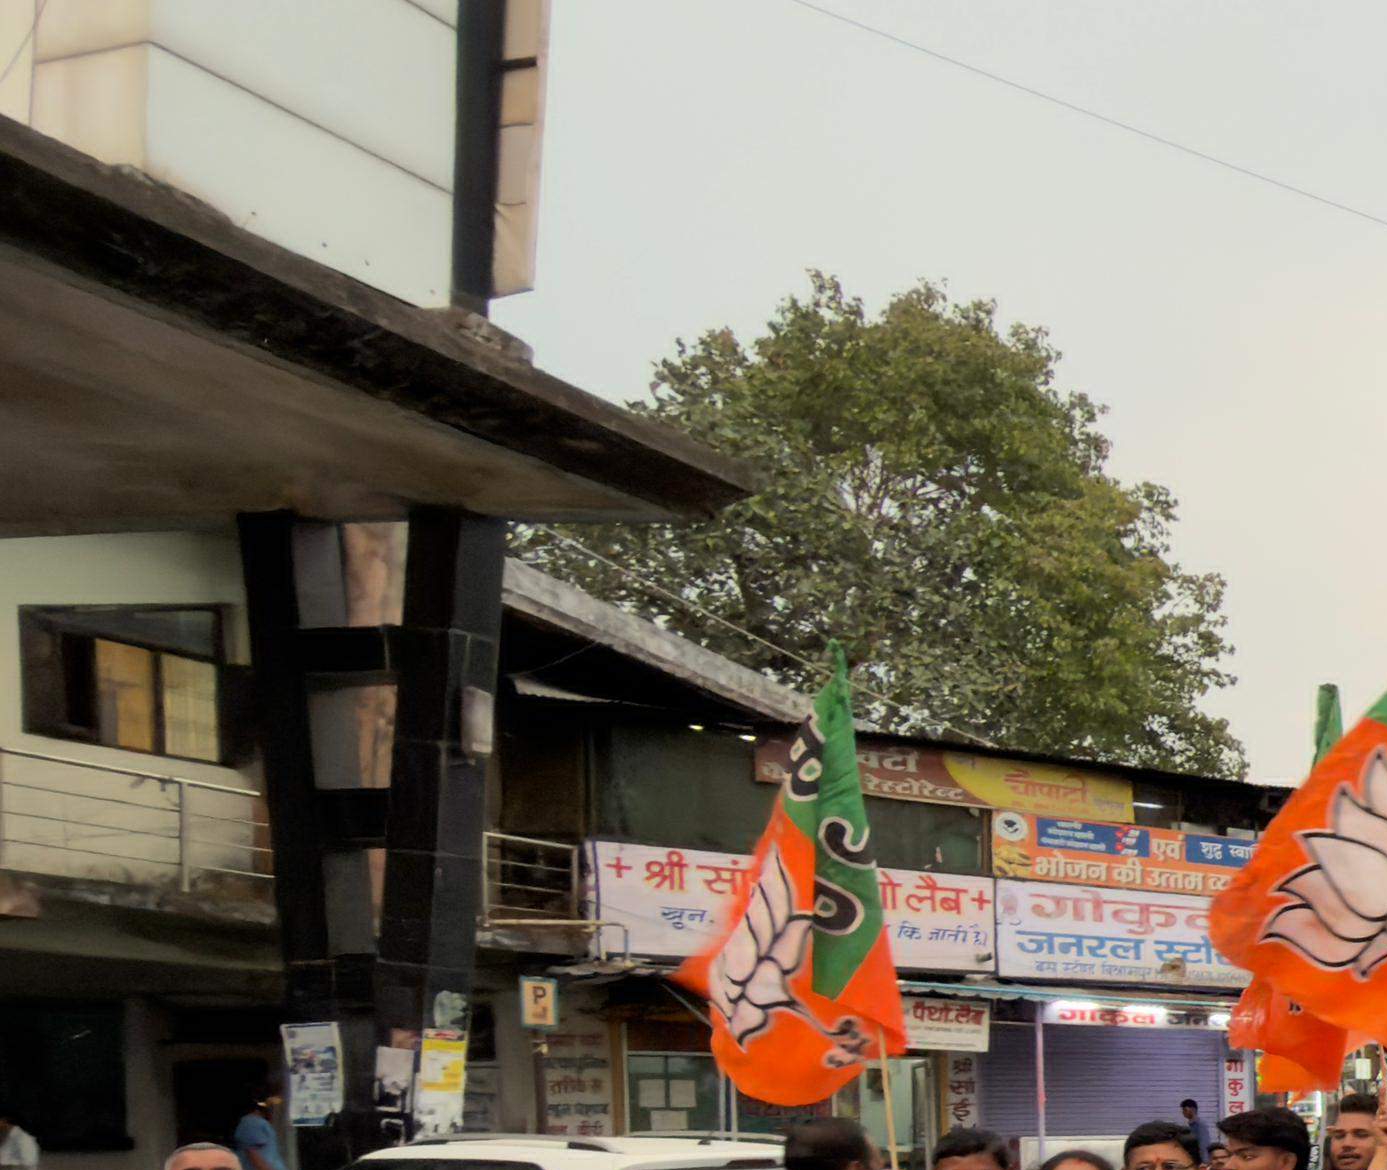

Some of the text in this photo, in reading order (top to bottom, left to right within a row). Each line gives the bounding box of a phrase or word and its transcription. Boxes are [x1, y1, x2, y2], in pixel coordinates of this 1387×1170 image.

[1151, 834, 1187, 861] एवं
[644, 850, 689, 891] श्री
[1034, 850, 1107, 881] भोजन
[1111, 855, 1143, 885] की
[905, 874, 968, 915] लैब
[1015, 930, 1145, 961] जनरल
[532, 986, 546, 1004] P
